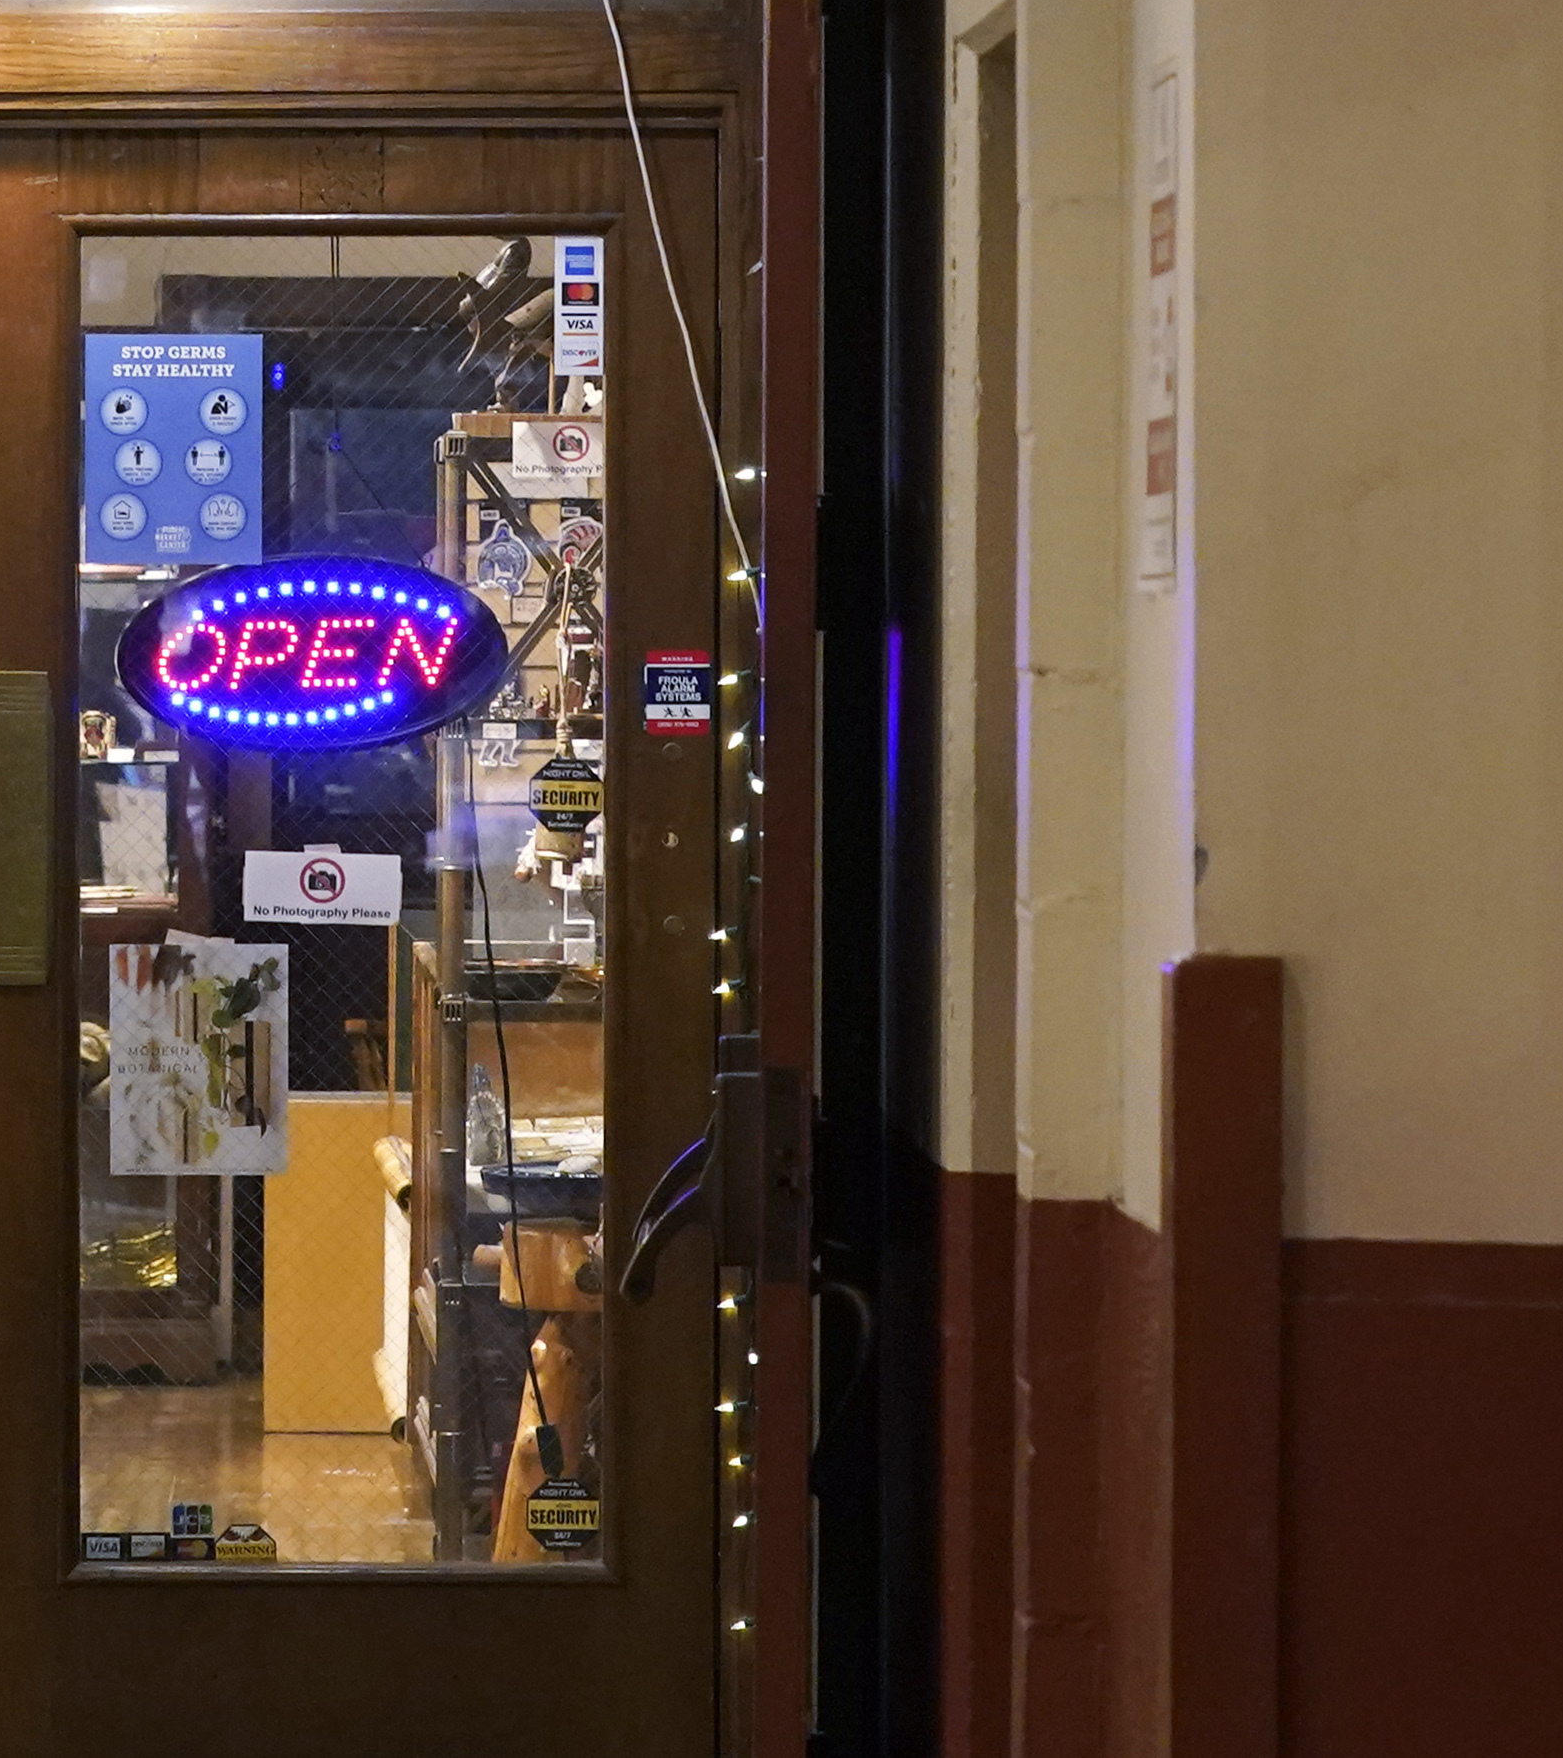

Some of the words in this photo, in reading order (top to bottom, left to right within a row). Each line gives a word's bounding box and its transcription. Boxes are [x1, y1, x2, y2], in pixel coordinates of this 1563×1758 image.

[566, 319, 594, 330] VISA
[121, 346, 165, 359] STOP
[168, 346, 226, 359] GERMS
[112, 364, 153, 377] STAY
[156, 364, 235, 377] HEALTHY
[515, 464, 529, 473] No
[531, 464, 594, 475] Photography
[157, 616, 459, 692] OPEN
[658, 676, 699, 685] FROULA
[660, 684, 696, 693] ALARM
[655, 692, 702, 702] SYSTEMS
[533, 789, 600, 806] SECURITY
[253, 906, 270, 916] No
[274, 906, 348, 919] Photography
[352, 907, 391, 918] Please
[127, 1046, 191, 1057] MODERN
[530, 1508, 597, 1525] SECURITY
[89, 1543, 118, 1553] VISA
[217, 1543, 275, 1556] WARNING
